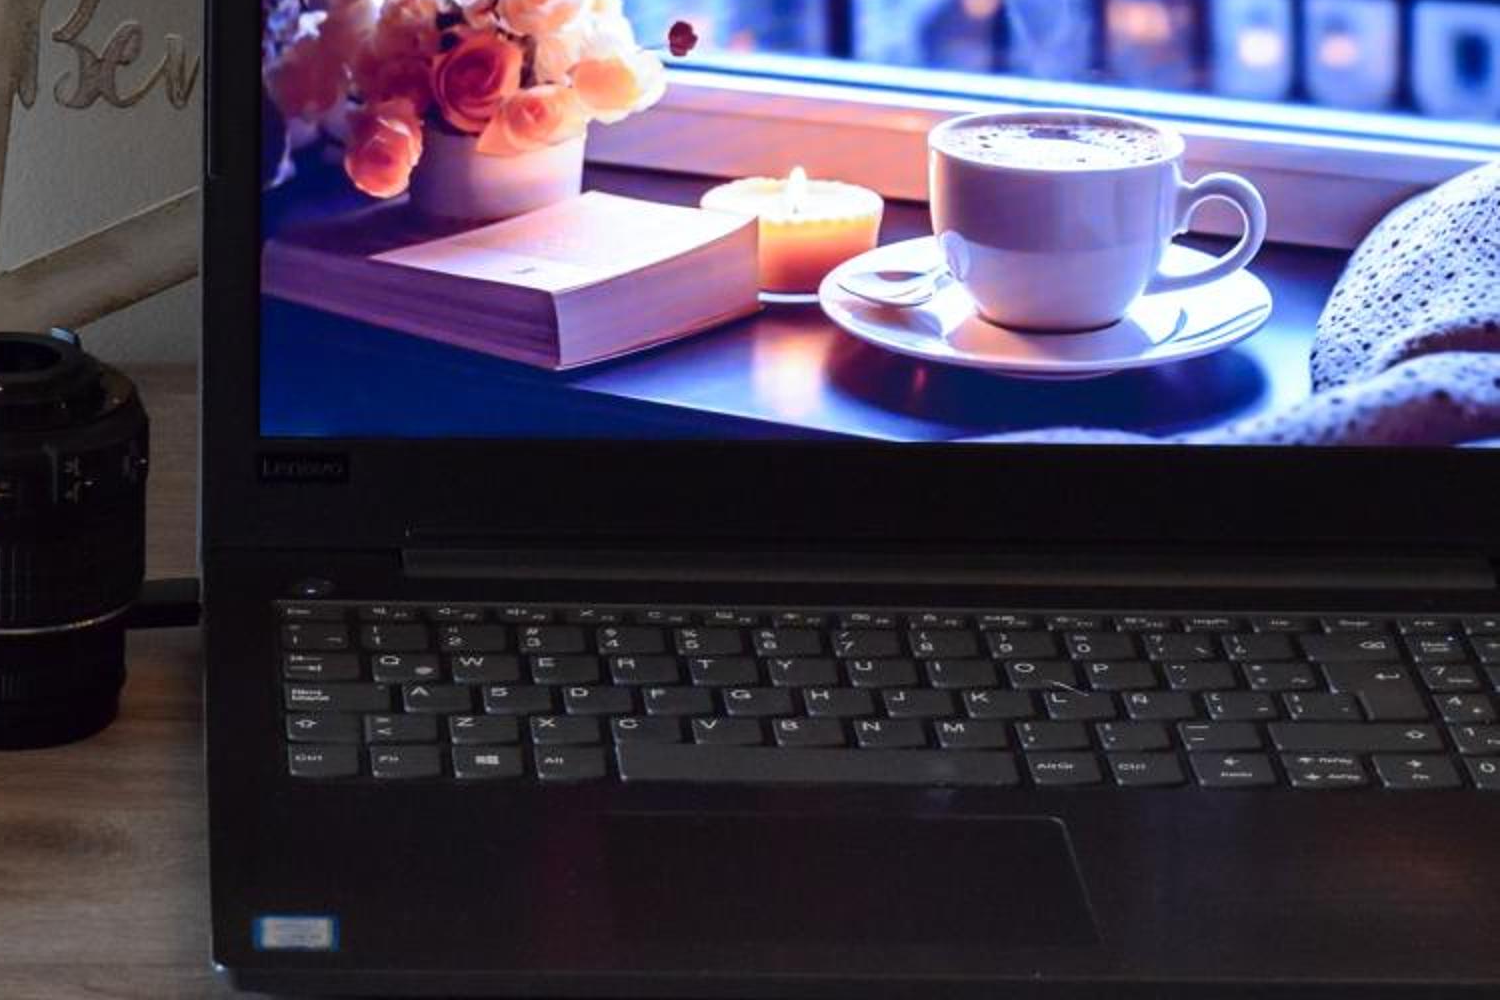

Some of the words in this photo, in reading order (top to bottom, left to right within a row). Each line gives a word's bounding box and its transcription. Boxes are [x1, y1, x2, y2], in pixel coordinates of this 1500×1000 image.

[378, 655, 401, 666] Q
[457, 656, 485, 667] W
[536, 656, 556, 668] E
[696, 658, 715, 670] T
[777, 659, 793, 671] Y
[854, 660, 874, 671] U
[1013, 662, 1036, 673] O
[410, 686, 430, 697] A
[490, 686, 509, 697] S
[570, 687, 589, 698] D
[730, 688, 753, 700] G
[811, 689, 830, 701] H
[971, 691, 989, 703] K
[1051, 692, 1068, 704] L
[455, 716, 475, 727] Z
[538, 716, 557, 728] X
[699, 719, 718, 729] V
[780, 719, 800, 731] B
[861, 720, 881, 732] N
[942, 721, 965, 734] M
